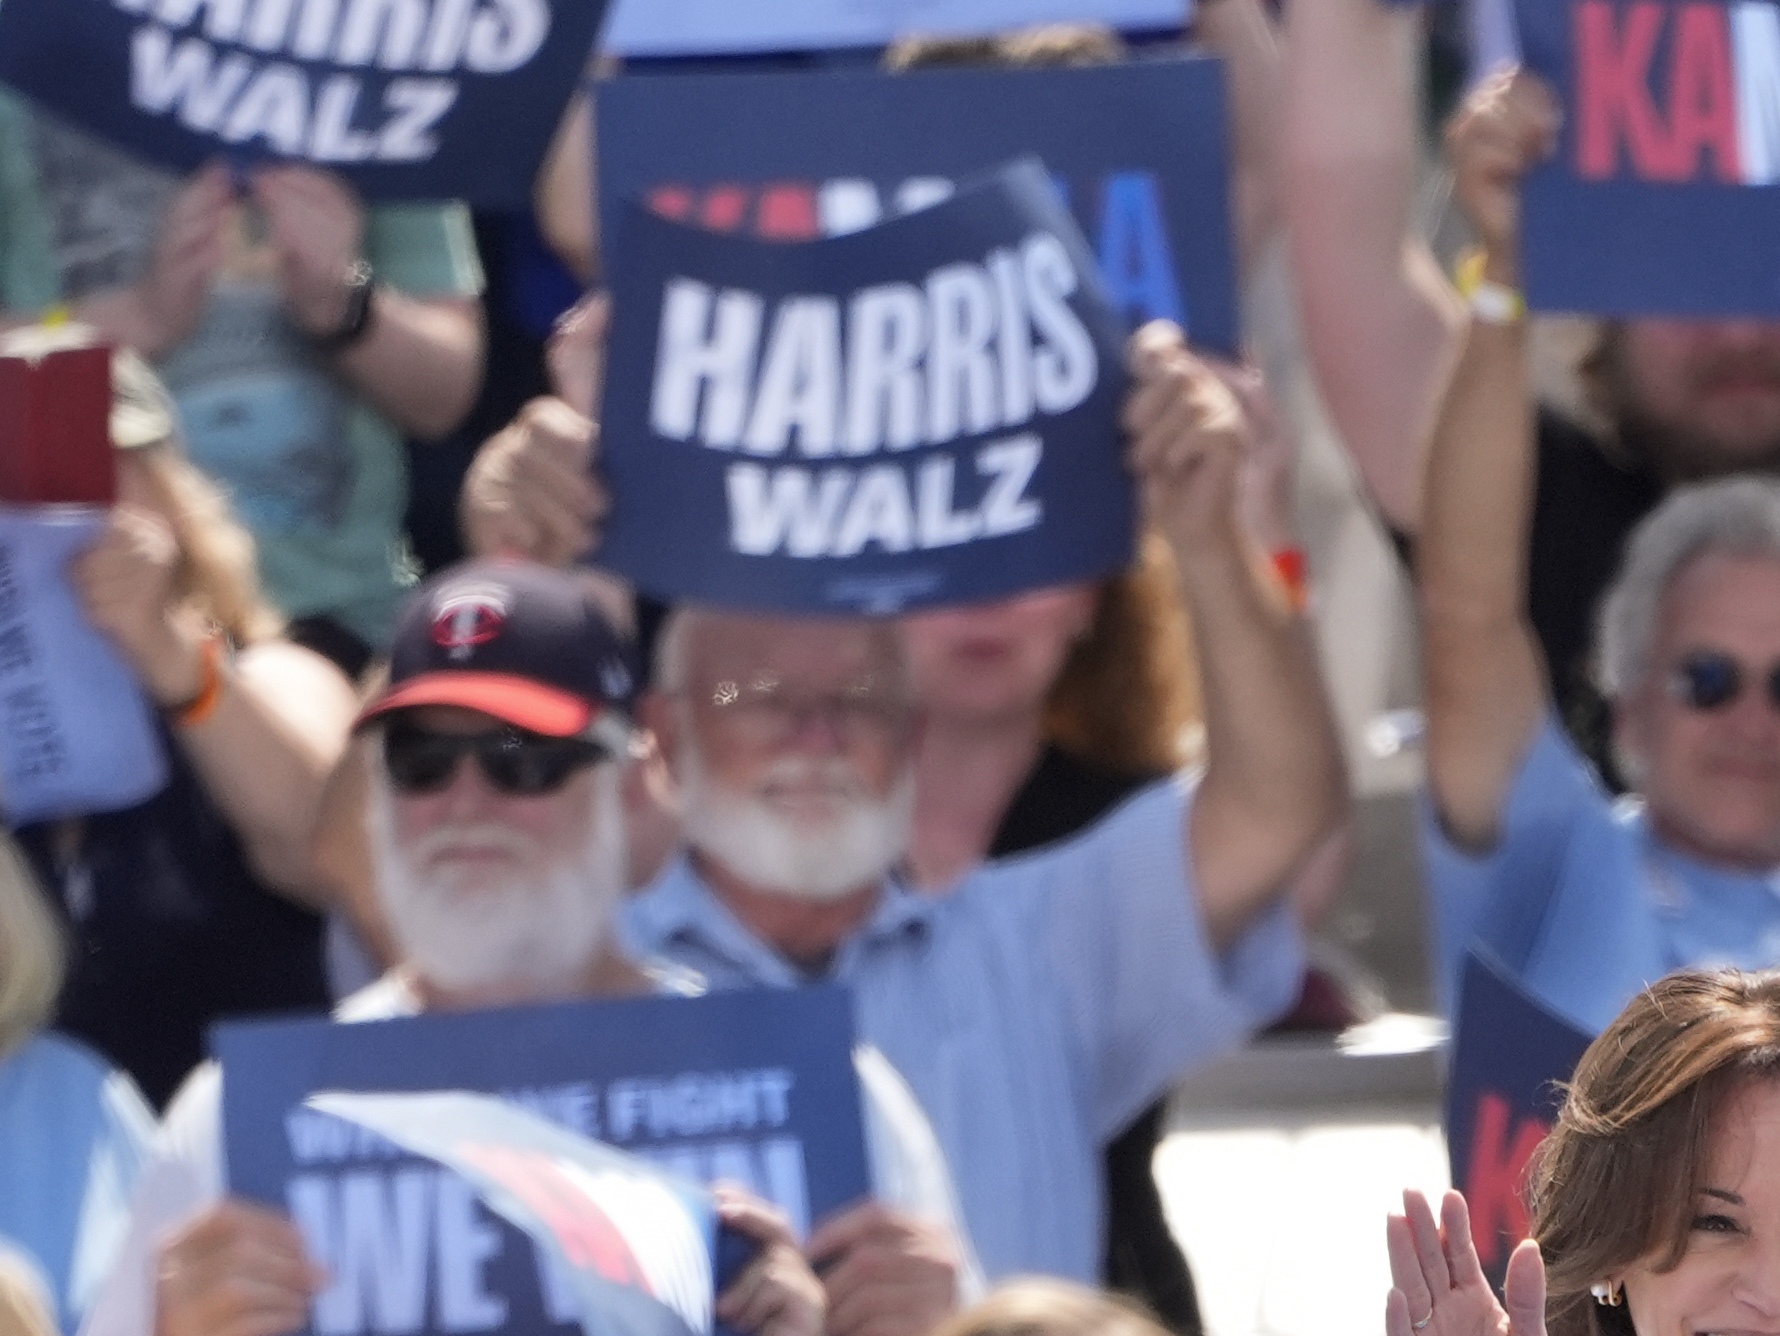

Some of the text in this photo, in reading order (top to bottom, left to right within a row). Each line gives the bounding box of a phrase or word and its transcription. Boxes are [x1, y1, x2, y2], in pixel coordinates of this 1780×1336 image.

[131, 24, 462, 162] WALZ
[651, 232, 1096, 460] HARRIS
[725, 434, 1043, 558] WALZ
[608, 1068, 792, 1138] FIGHT
